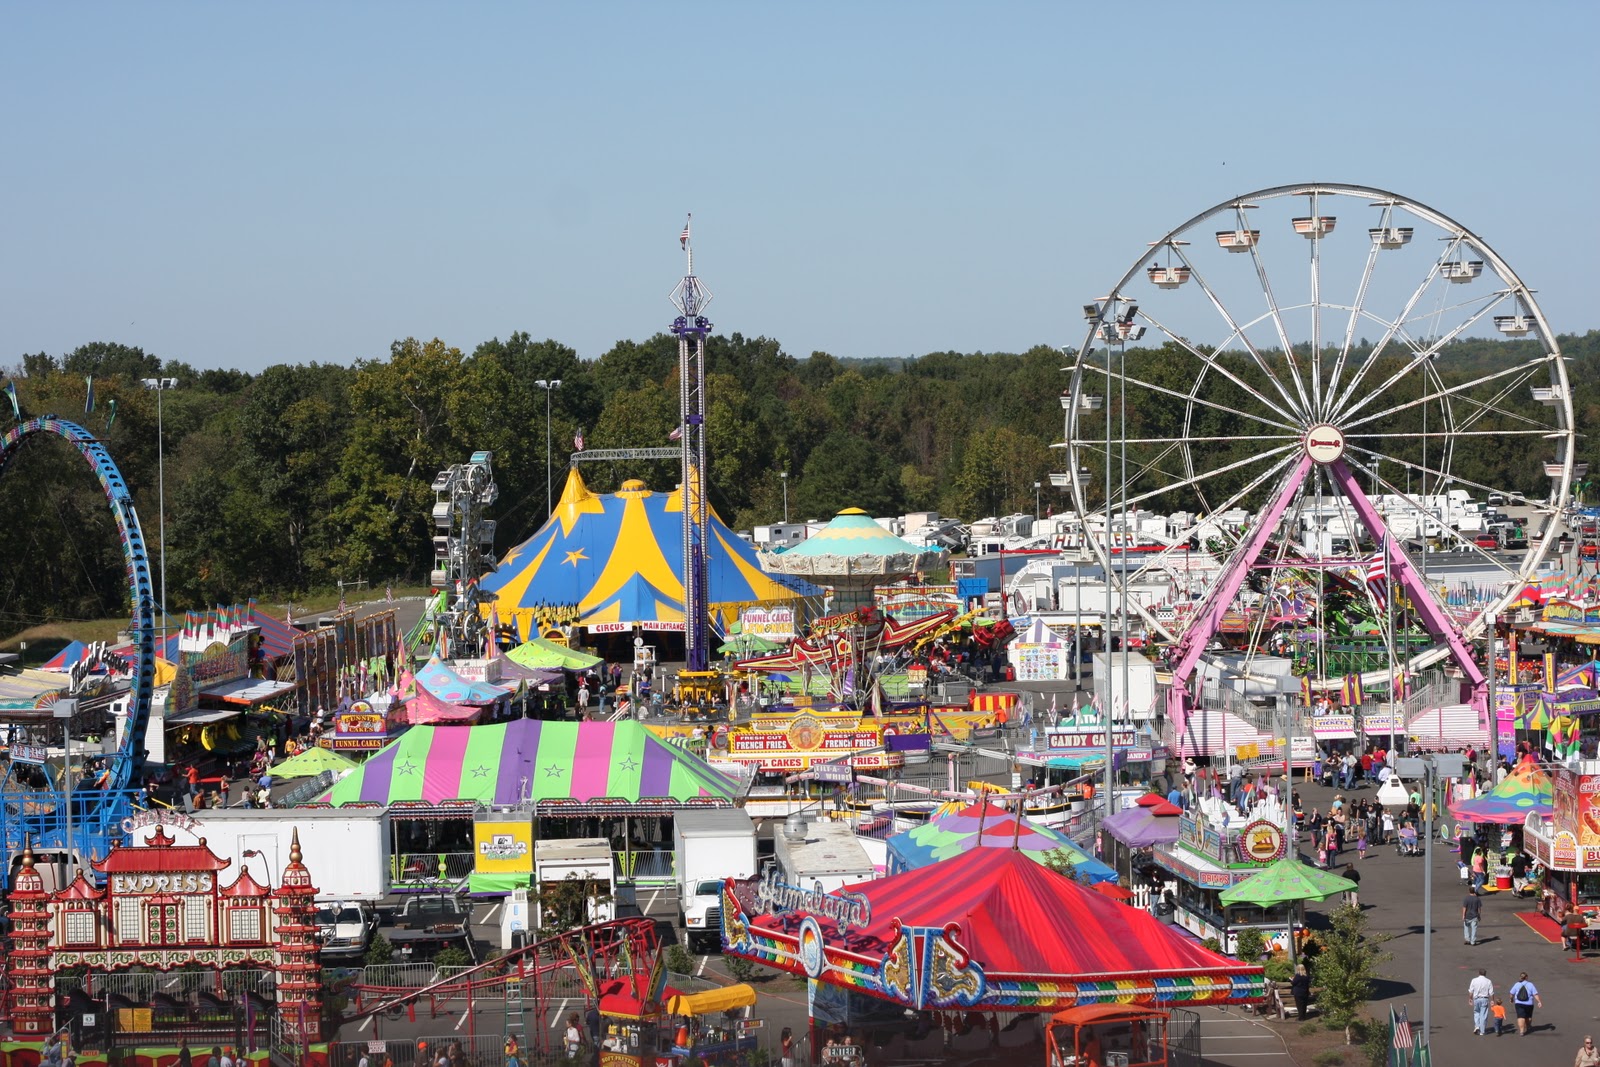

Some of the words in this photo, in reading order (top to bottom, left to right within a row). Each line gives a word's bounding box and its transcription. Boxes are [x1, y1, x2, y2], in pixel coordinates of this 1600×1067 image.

[743, 613, 770, 623] FUNNEL
[771, 612, 792, 622] CAKES
[596, 623, 624, 633] CIRCUS
[660, 622, 685, 630] ENTRANCE
[345, 715, 375, 724] FUNNEL
[335, 740, 360, 748] FUNNEL
[825, 740, 852, 748] FRENCH
[855, 739, 876, 747] FRIES
[1051, 734, 1087, 747] CANDY
[1092, 733, 1133, 746] CATLE
[736, 741, 763, 749] FRENCH
[766, 741, 787, 749] FRIES
[771, 758, 801, 767] CAKES
[852, 756, 879, 765] FRIES
[112, 873, 213, 894] EXPRESS
[830, 1047, 855, 1056] ENTER
[602, 1055, 614, 1063] SOFT
[615, 1055, 639, 1066] PRETZELS
